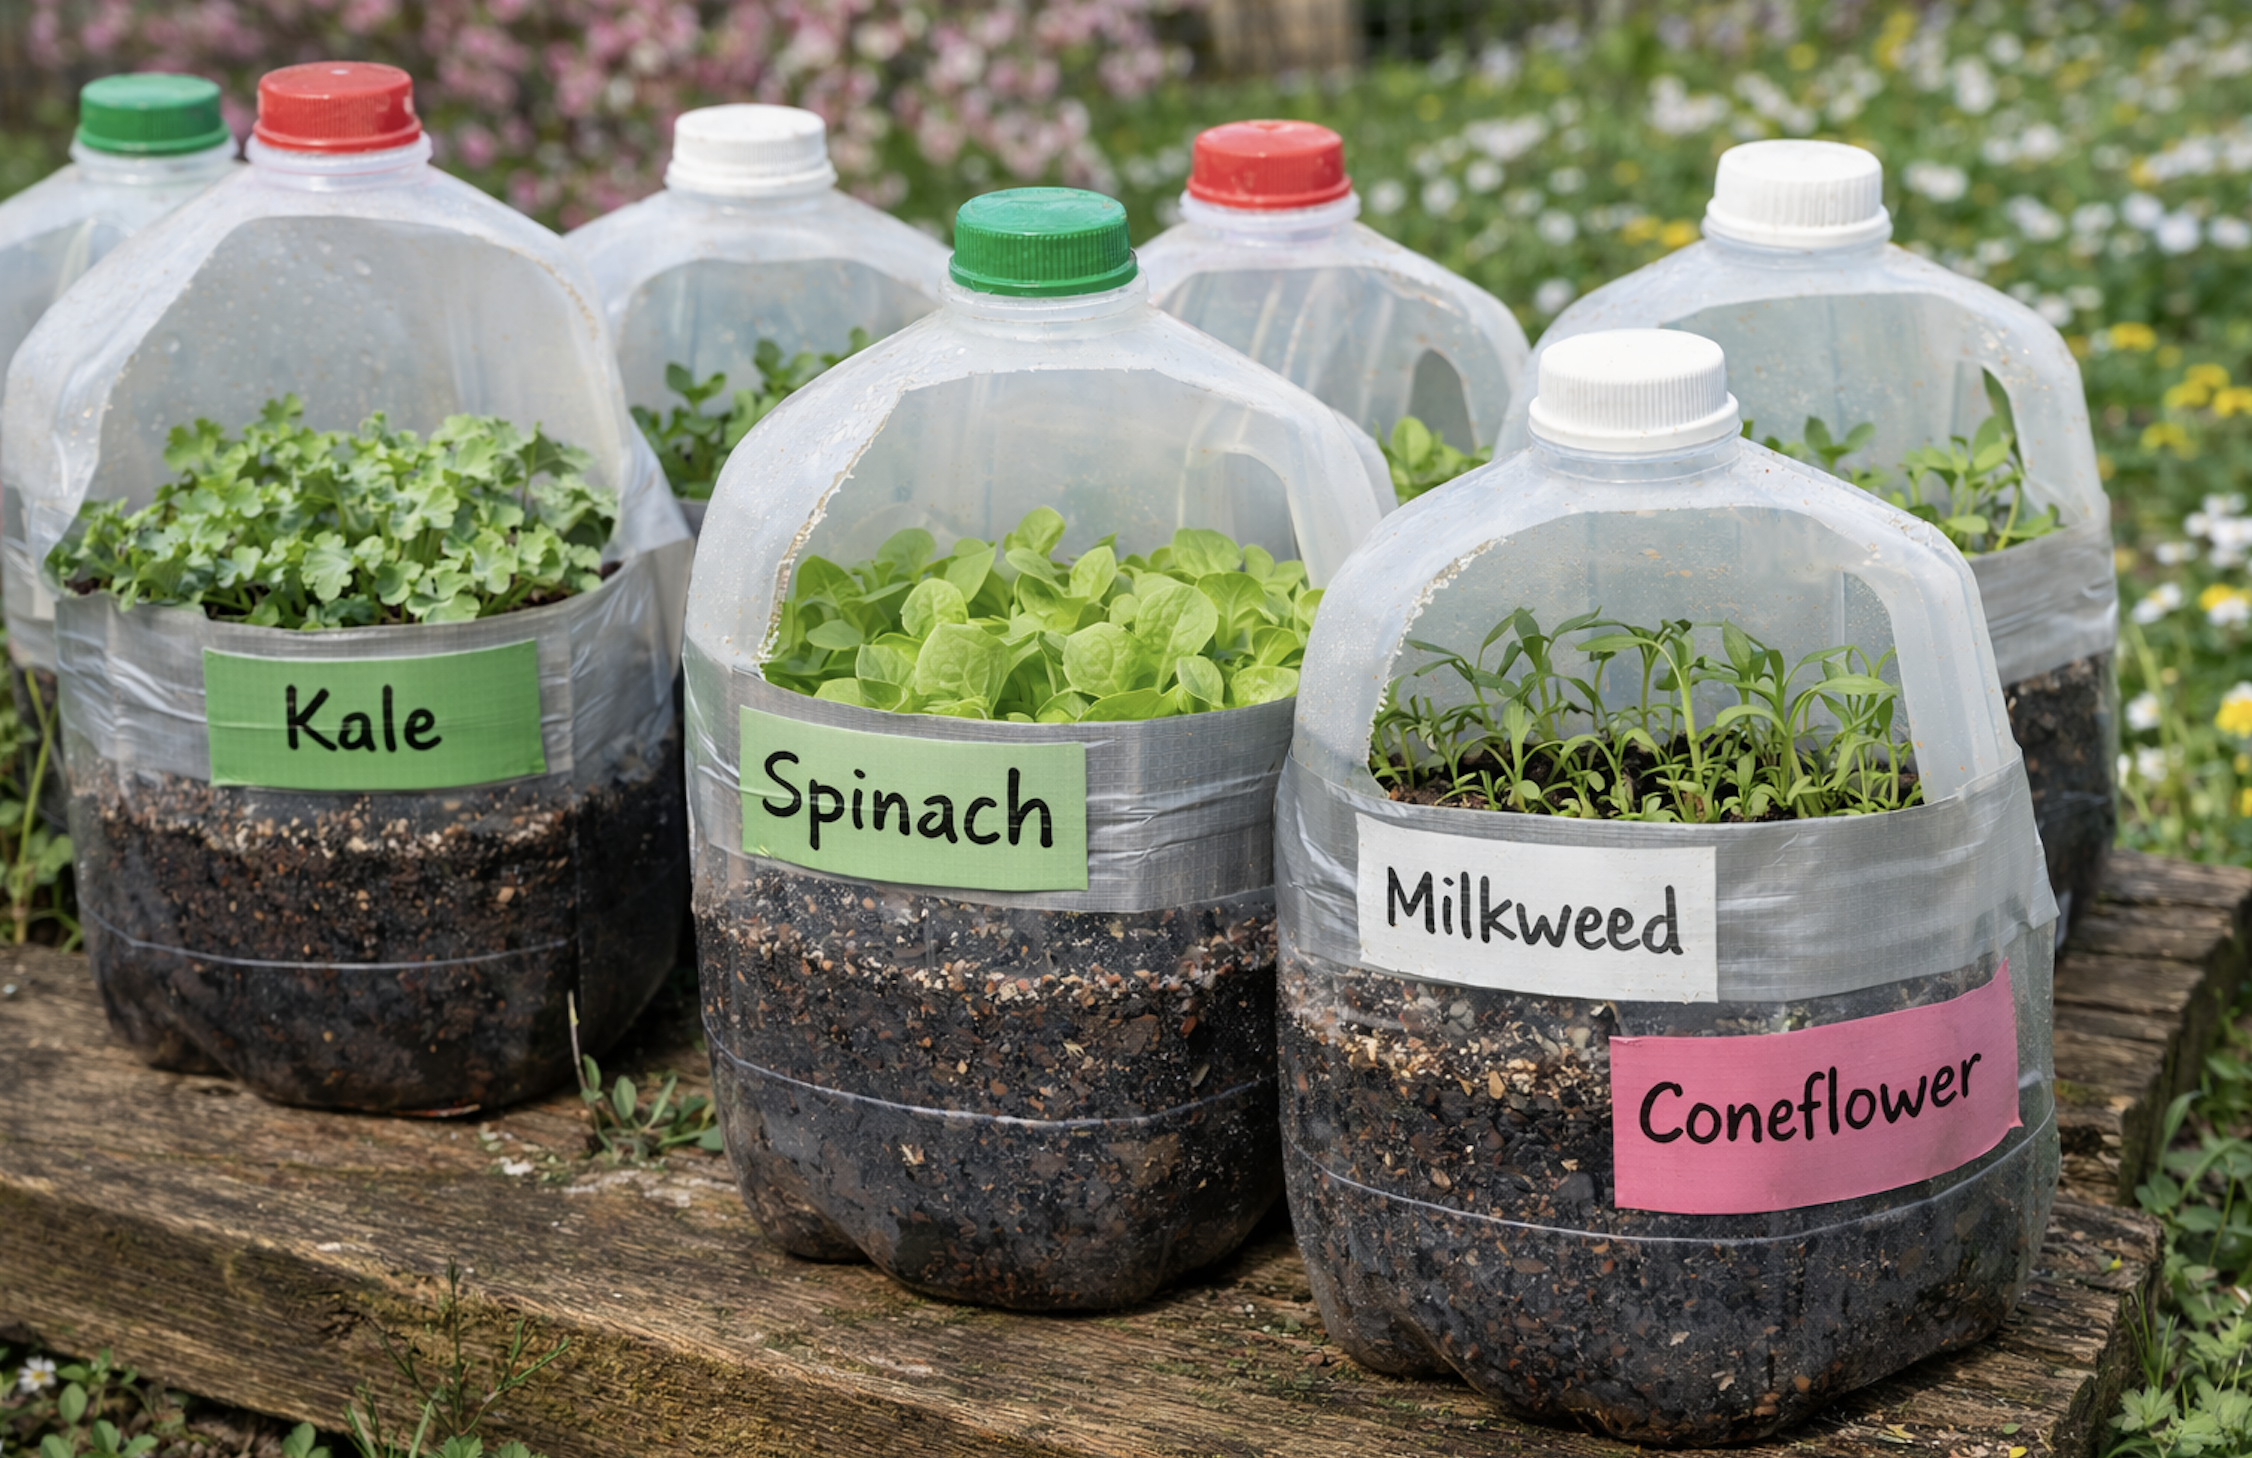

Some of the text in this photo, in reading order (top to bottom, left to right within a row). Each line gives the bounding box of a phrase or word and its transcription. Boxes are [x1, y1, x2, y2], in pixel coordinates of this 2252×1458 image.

[285, 684, 443, 753] Kale
[762, 750, 1053, 851] Spinach
[1387, 866, 1684, 955] Milkweed
[1639, 1052, 1983, 1145] Coneflower
